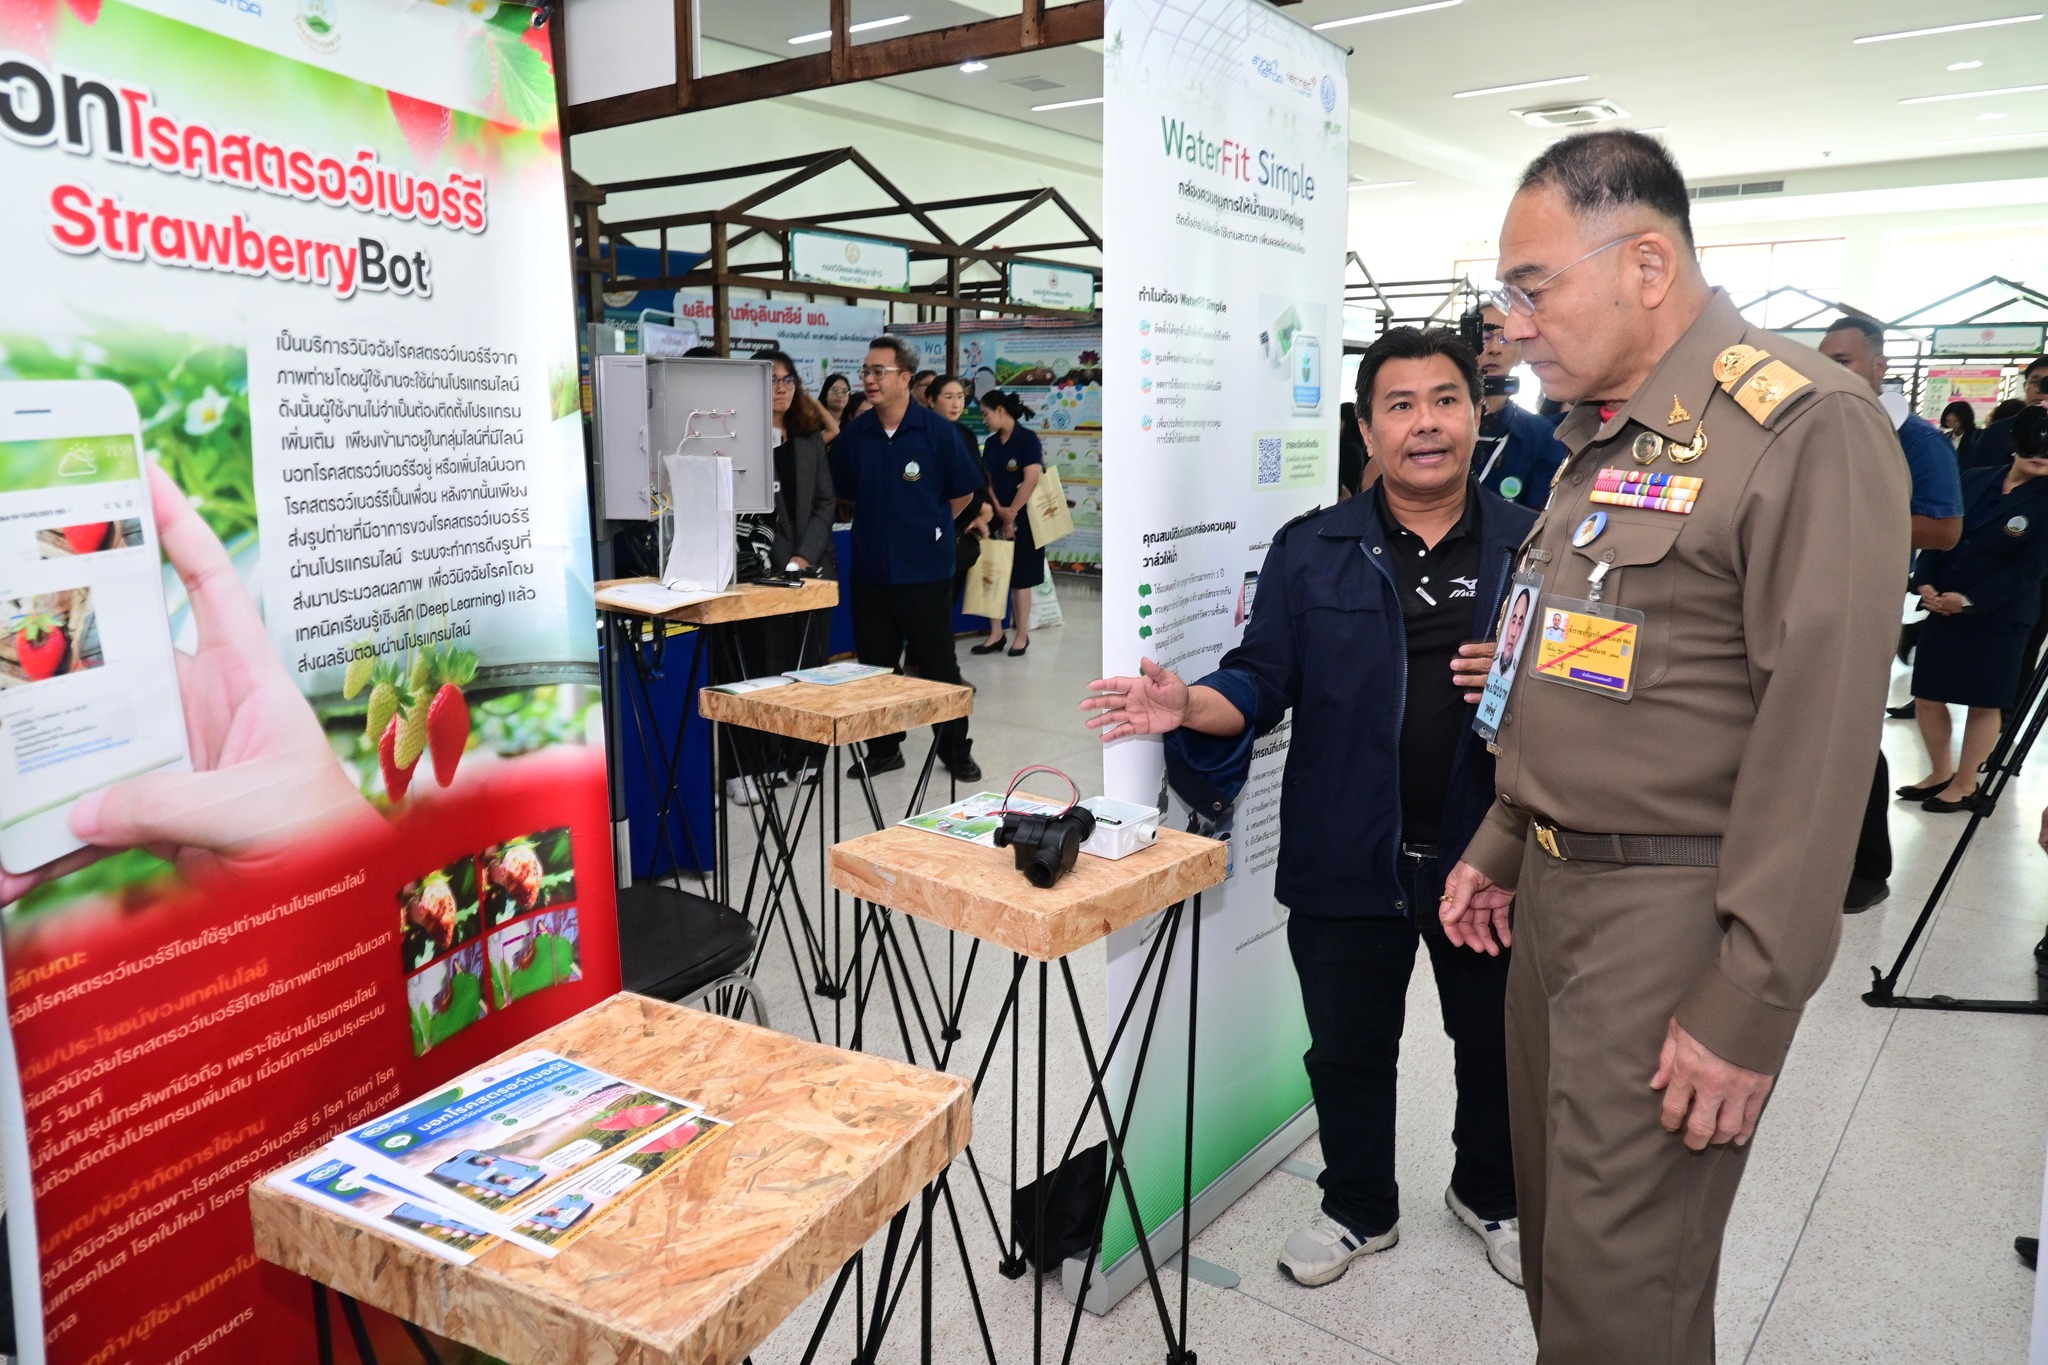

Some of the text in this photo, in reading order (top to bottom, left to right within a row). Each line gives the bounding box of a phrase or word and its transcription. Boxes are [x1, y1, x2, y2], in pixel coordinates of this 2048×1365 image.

[1161, 115, 1315, 205] WaterFit Simple
[50, 184, 428, 293] StrawberryBot
[281, 426, 335, 452] เพิ่มเติม
[290, 532, 532, 579] ผ่านโปรแกรมไลน์ ระบบจะทำการดึงรูปที่
[292, 560, 534, 611] ส่งมาประมวลผลภาพ เพื่อวินิจฉัยโรคโดย
[1448, 589, 1479, 599] MIZ
[295, 585, 536, 642] เทคนิคเรียนรู้เชิงลึก (Deep Learning) แล้ว
[57, 1086, 104, 1124] วินาที
[311, 1112, 320, 1127] 5
[323, 1102, 344, 1120] โรค
[345, 1076, 373, 1105] ได้แก่
[375, 1067, 395, 1084] โรค
